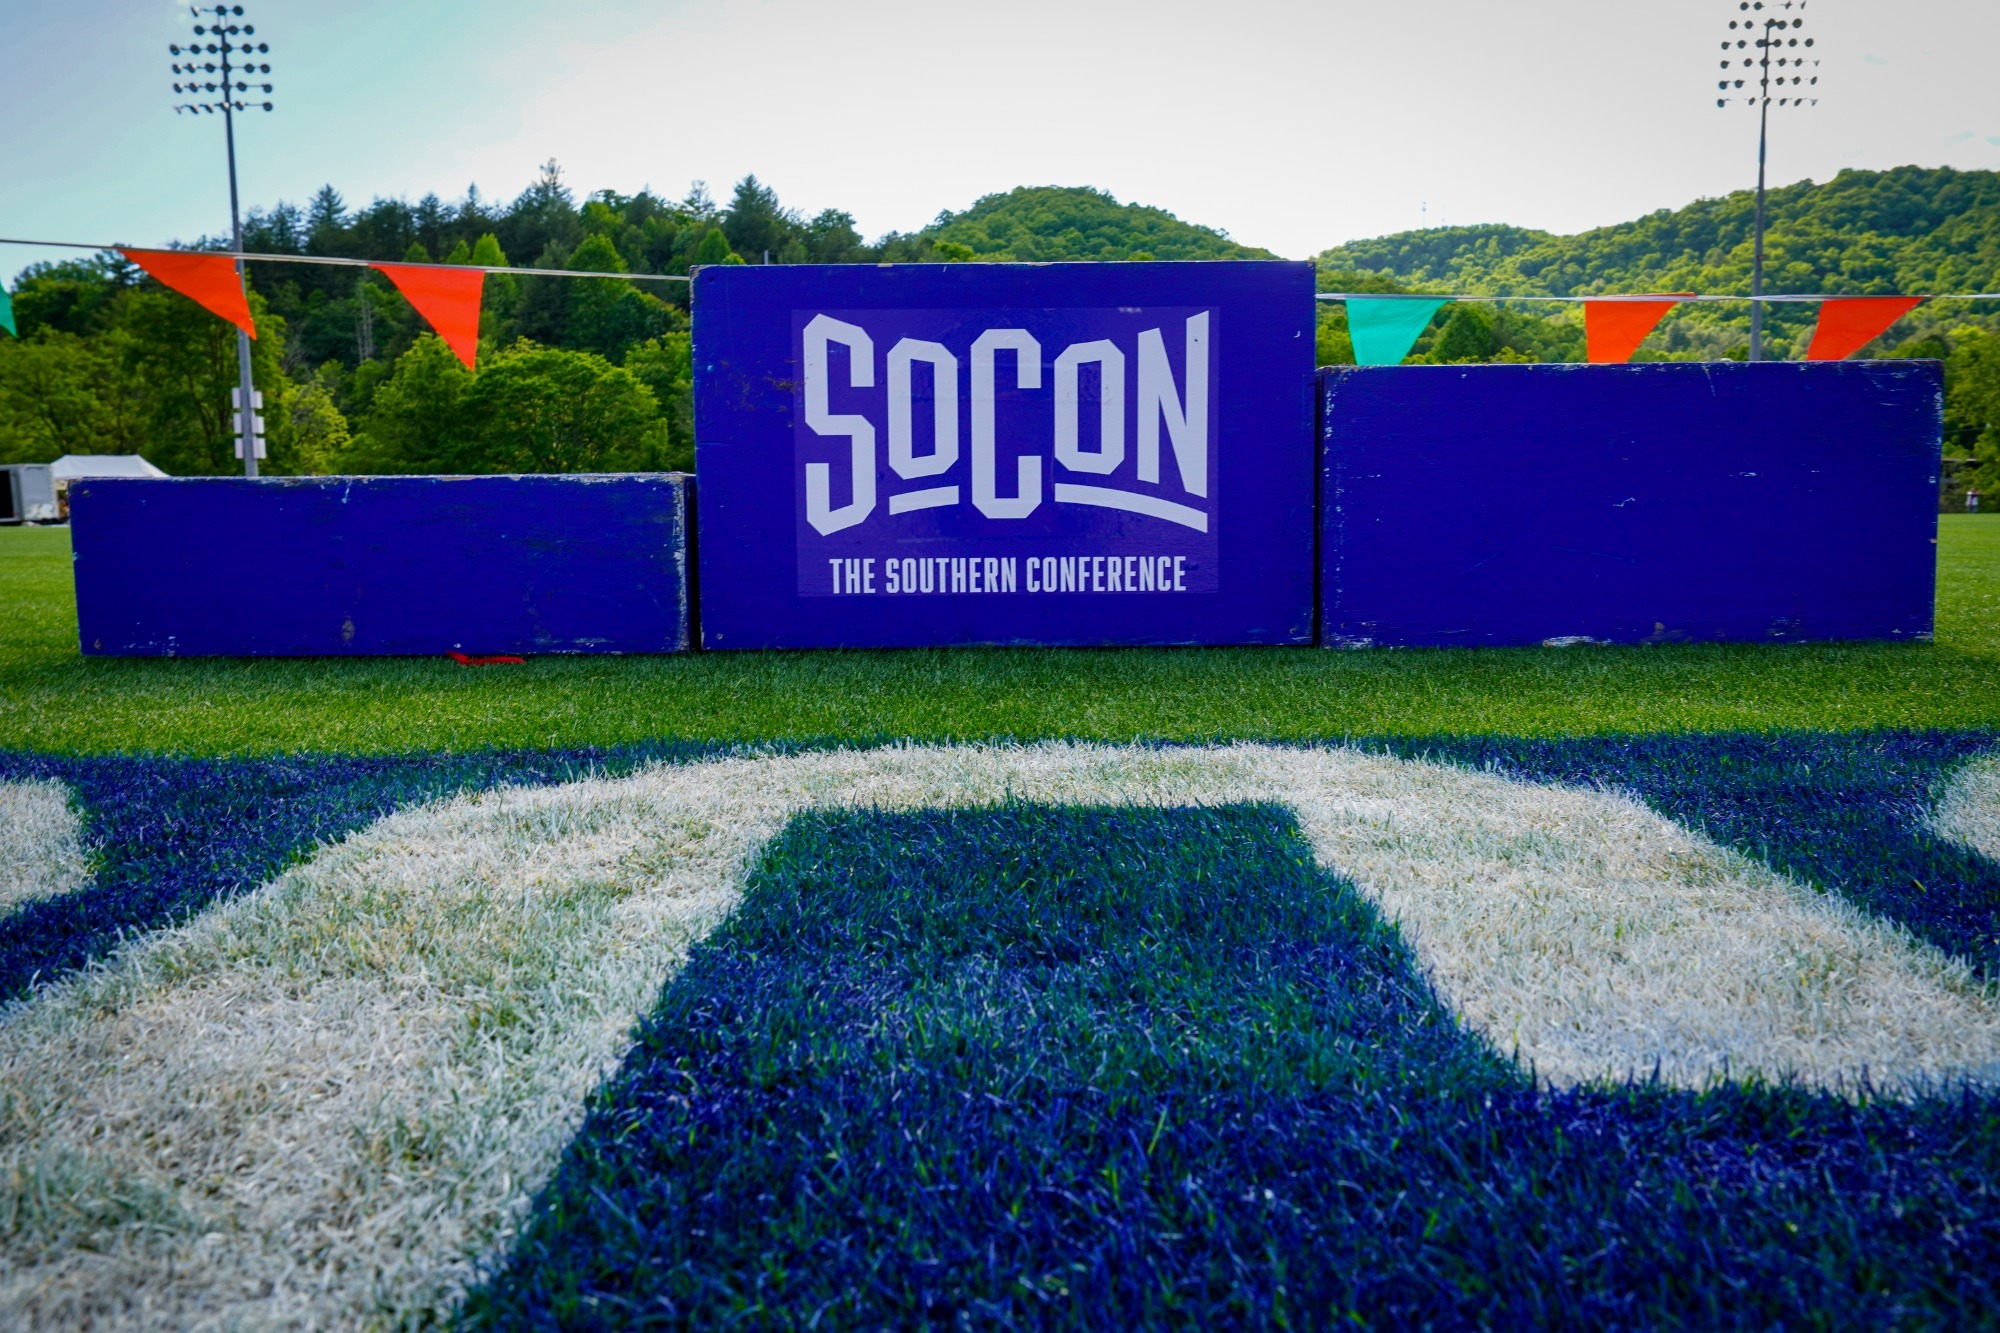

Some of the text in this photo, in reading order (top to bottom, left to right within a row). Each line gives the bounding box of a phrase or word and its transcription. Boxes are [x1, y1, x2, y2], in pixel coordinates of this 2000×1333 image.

[829, 556, 1186, 594] THE SOUTHERN CONFERENCE
